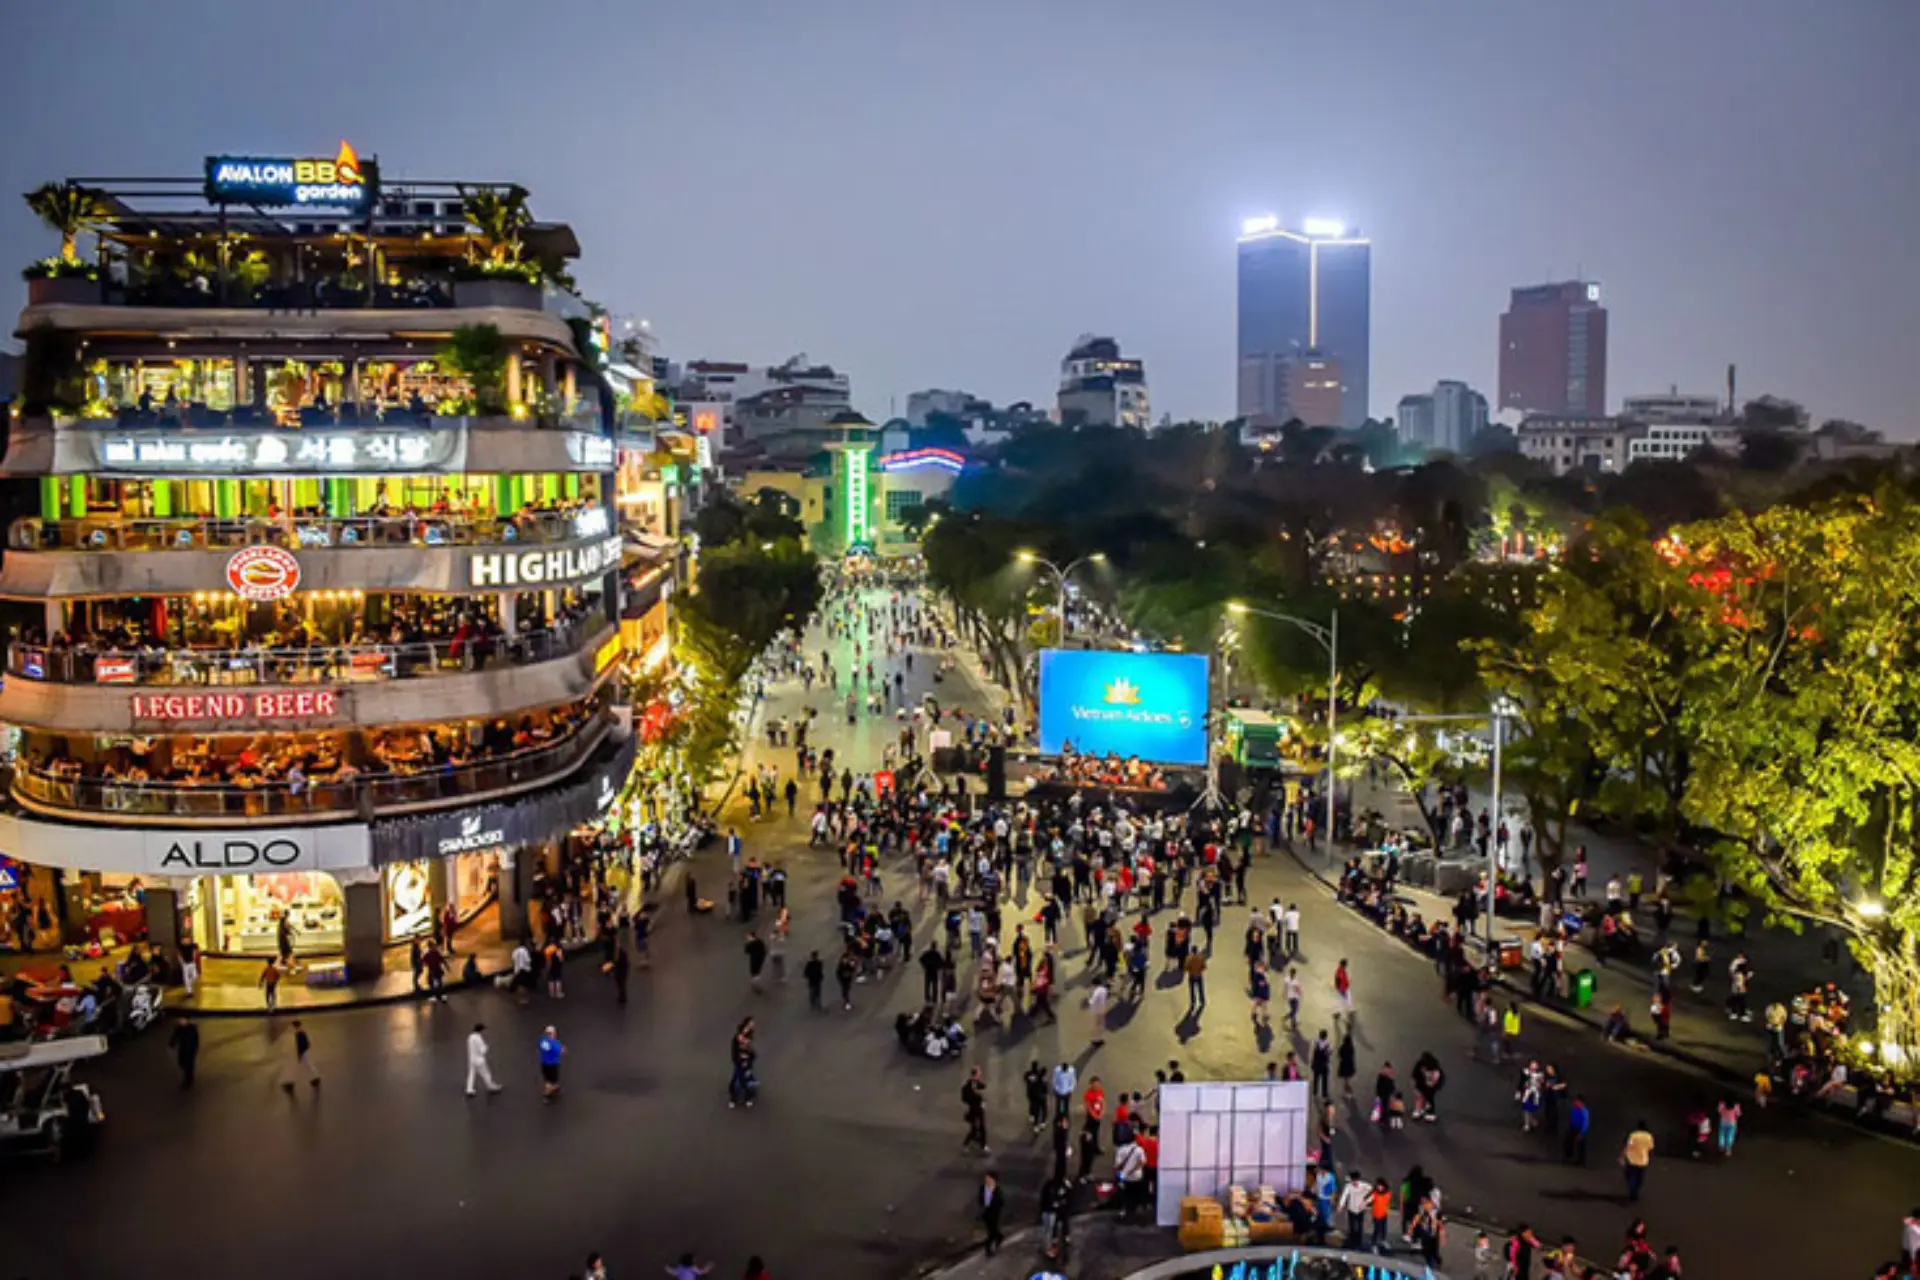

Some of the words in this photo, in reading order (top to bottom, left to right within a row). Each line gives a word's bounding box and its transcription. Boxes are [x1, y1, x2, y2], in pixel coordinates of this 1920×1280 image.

[217, 164, 293, 183] AVALON
[295, 184, 362, 202] garden
[132, 694, 245, 718] LEGEND
[254, 691, 335, 718] BEER
[161, 839, 301, 868] ALDO
